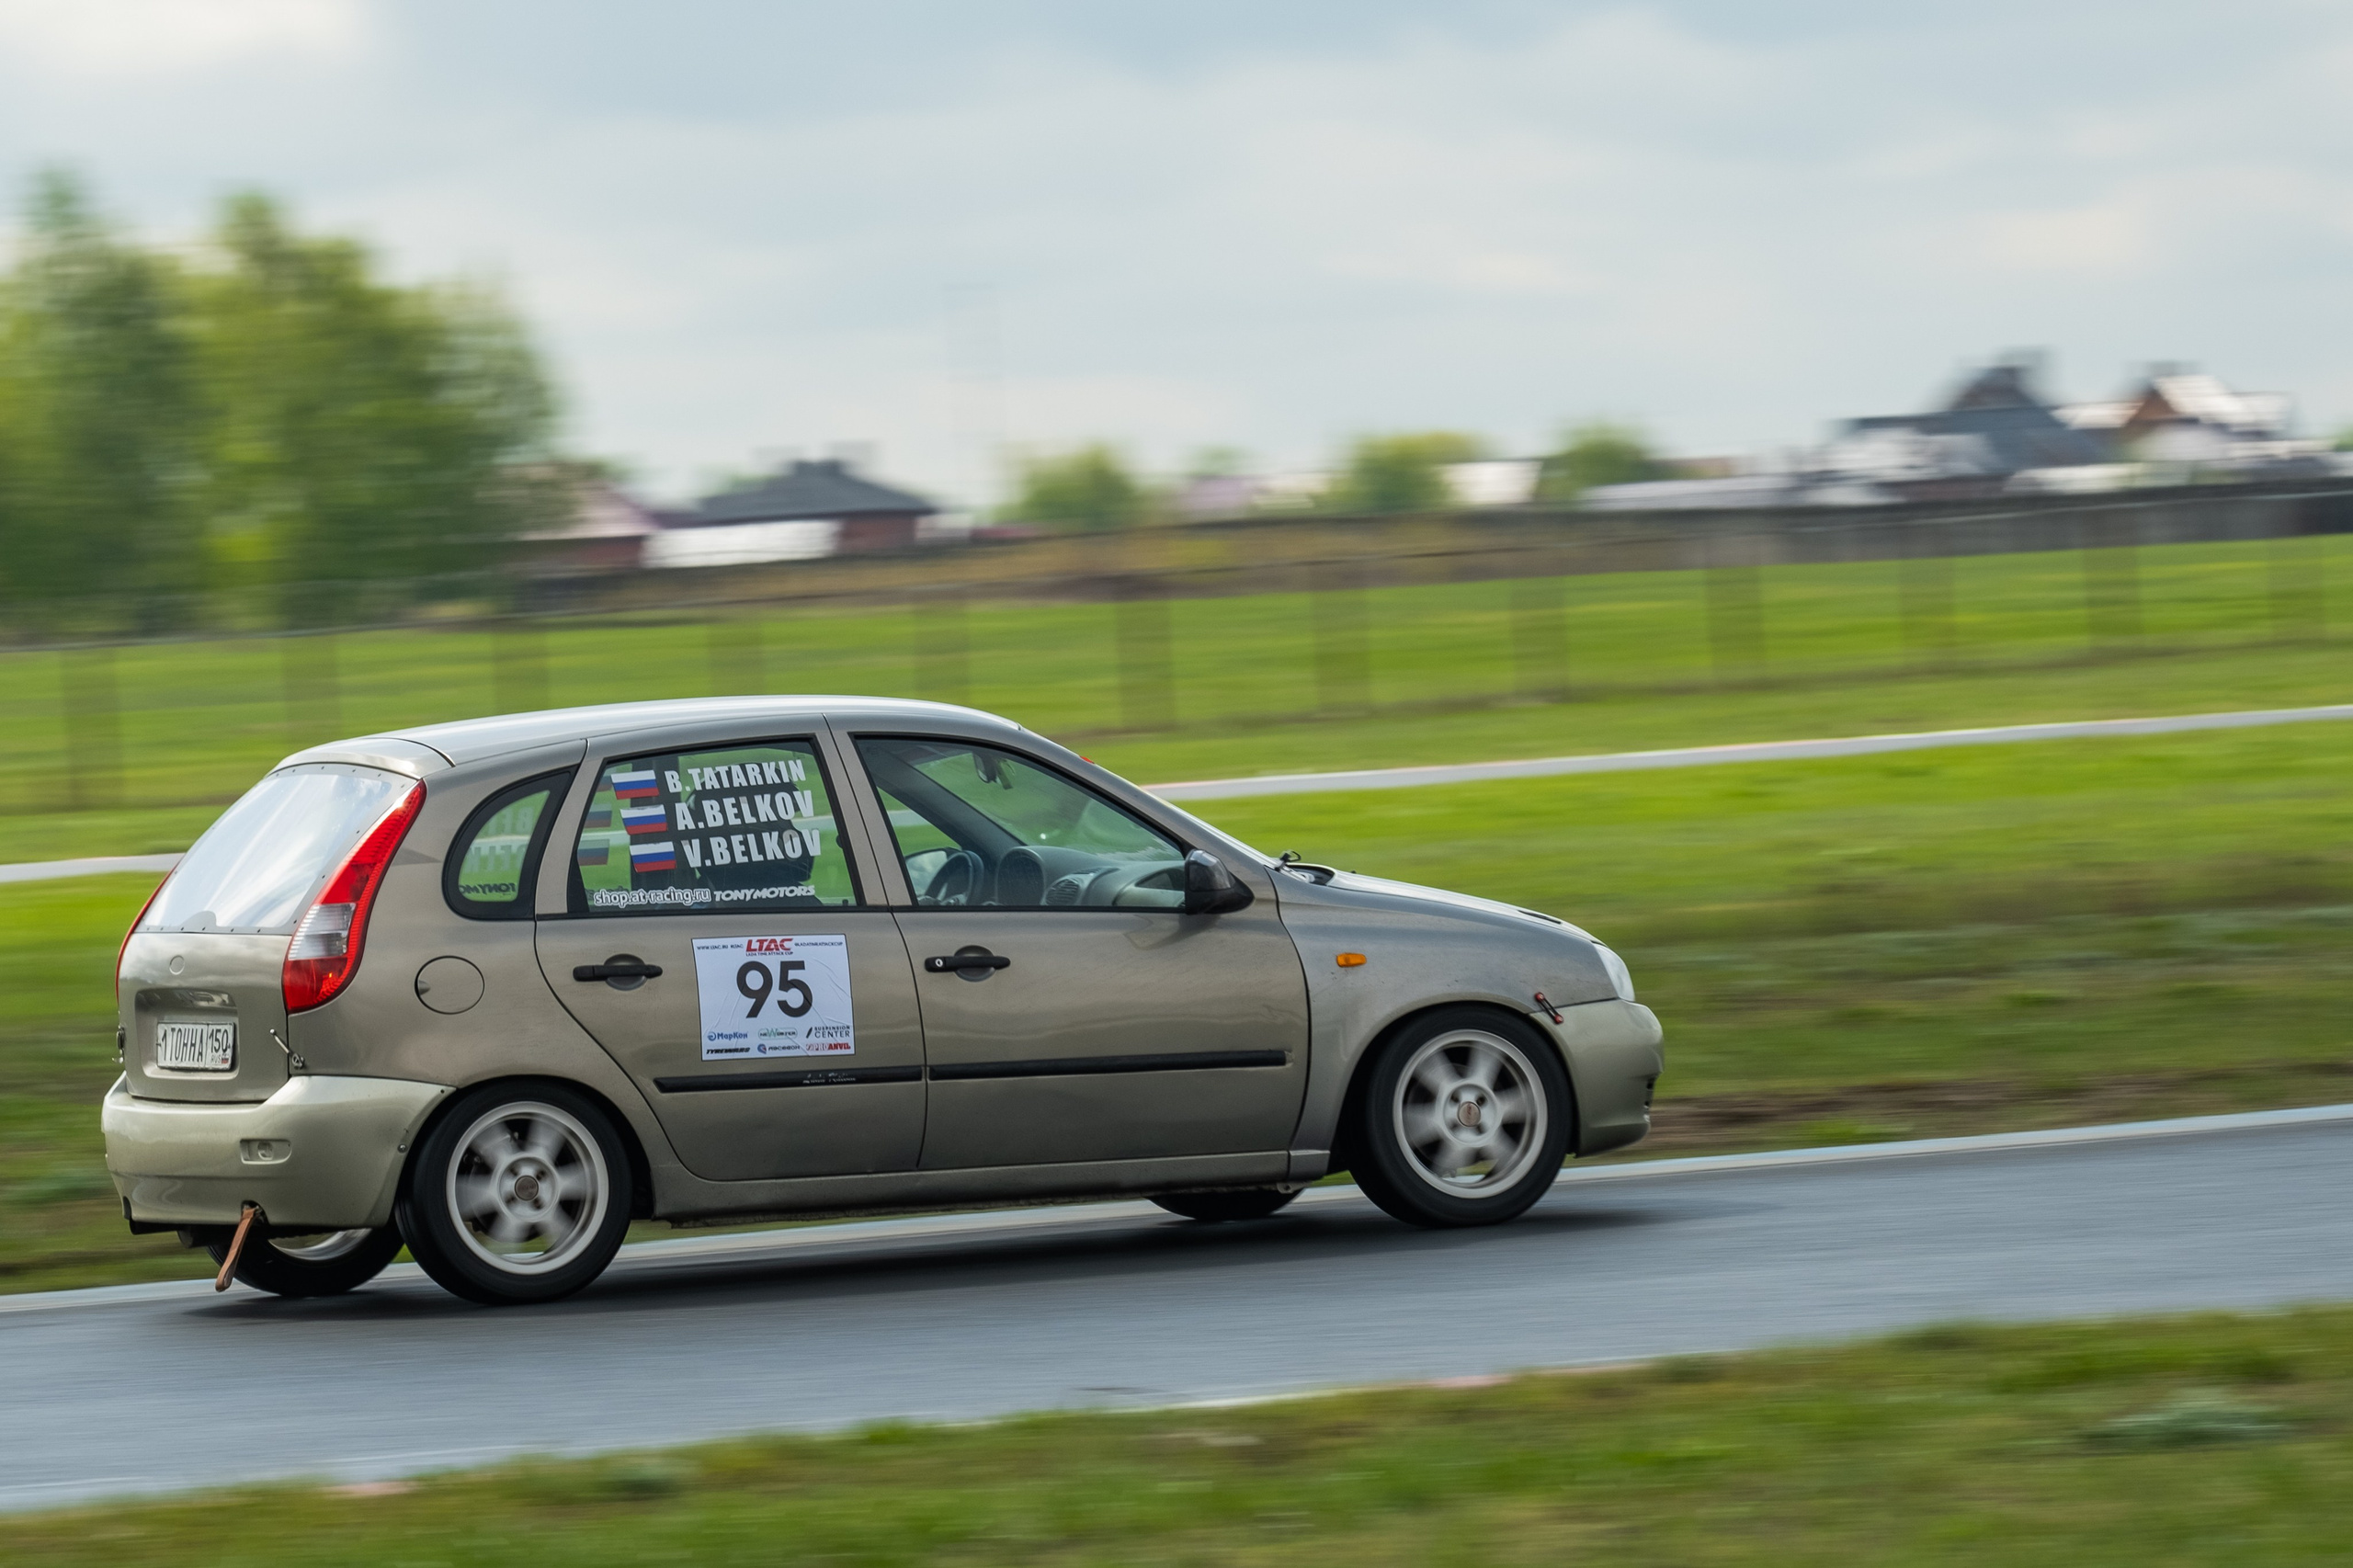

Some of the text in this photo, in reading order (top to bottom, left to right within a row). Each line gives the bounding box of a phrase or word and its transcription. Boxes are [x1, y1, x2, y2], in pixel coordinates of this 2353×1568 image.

[664, 758, 807, 794] B.TATARKIN
[674, 790, 814, 831] A.BELKOV
[680, 828, 822, 869] V.BELKOV
[594, 886, 711, 908] shop.at-racing.ru
[713, 884, 816, 903] TONYMOTORS
[745, 937, 794, 952] LTAC
[736, 960, 813, 1019] 95
[209, 1028, 229, 1054] 150
[814, 1030, 851, 1040] CENTER
